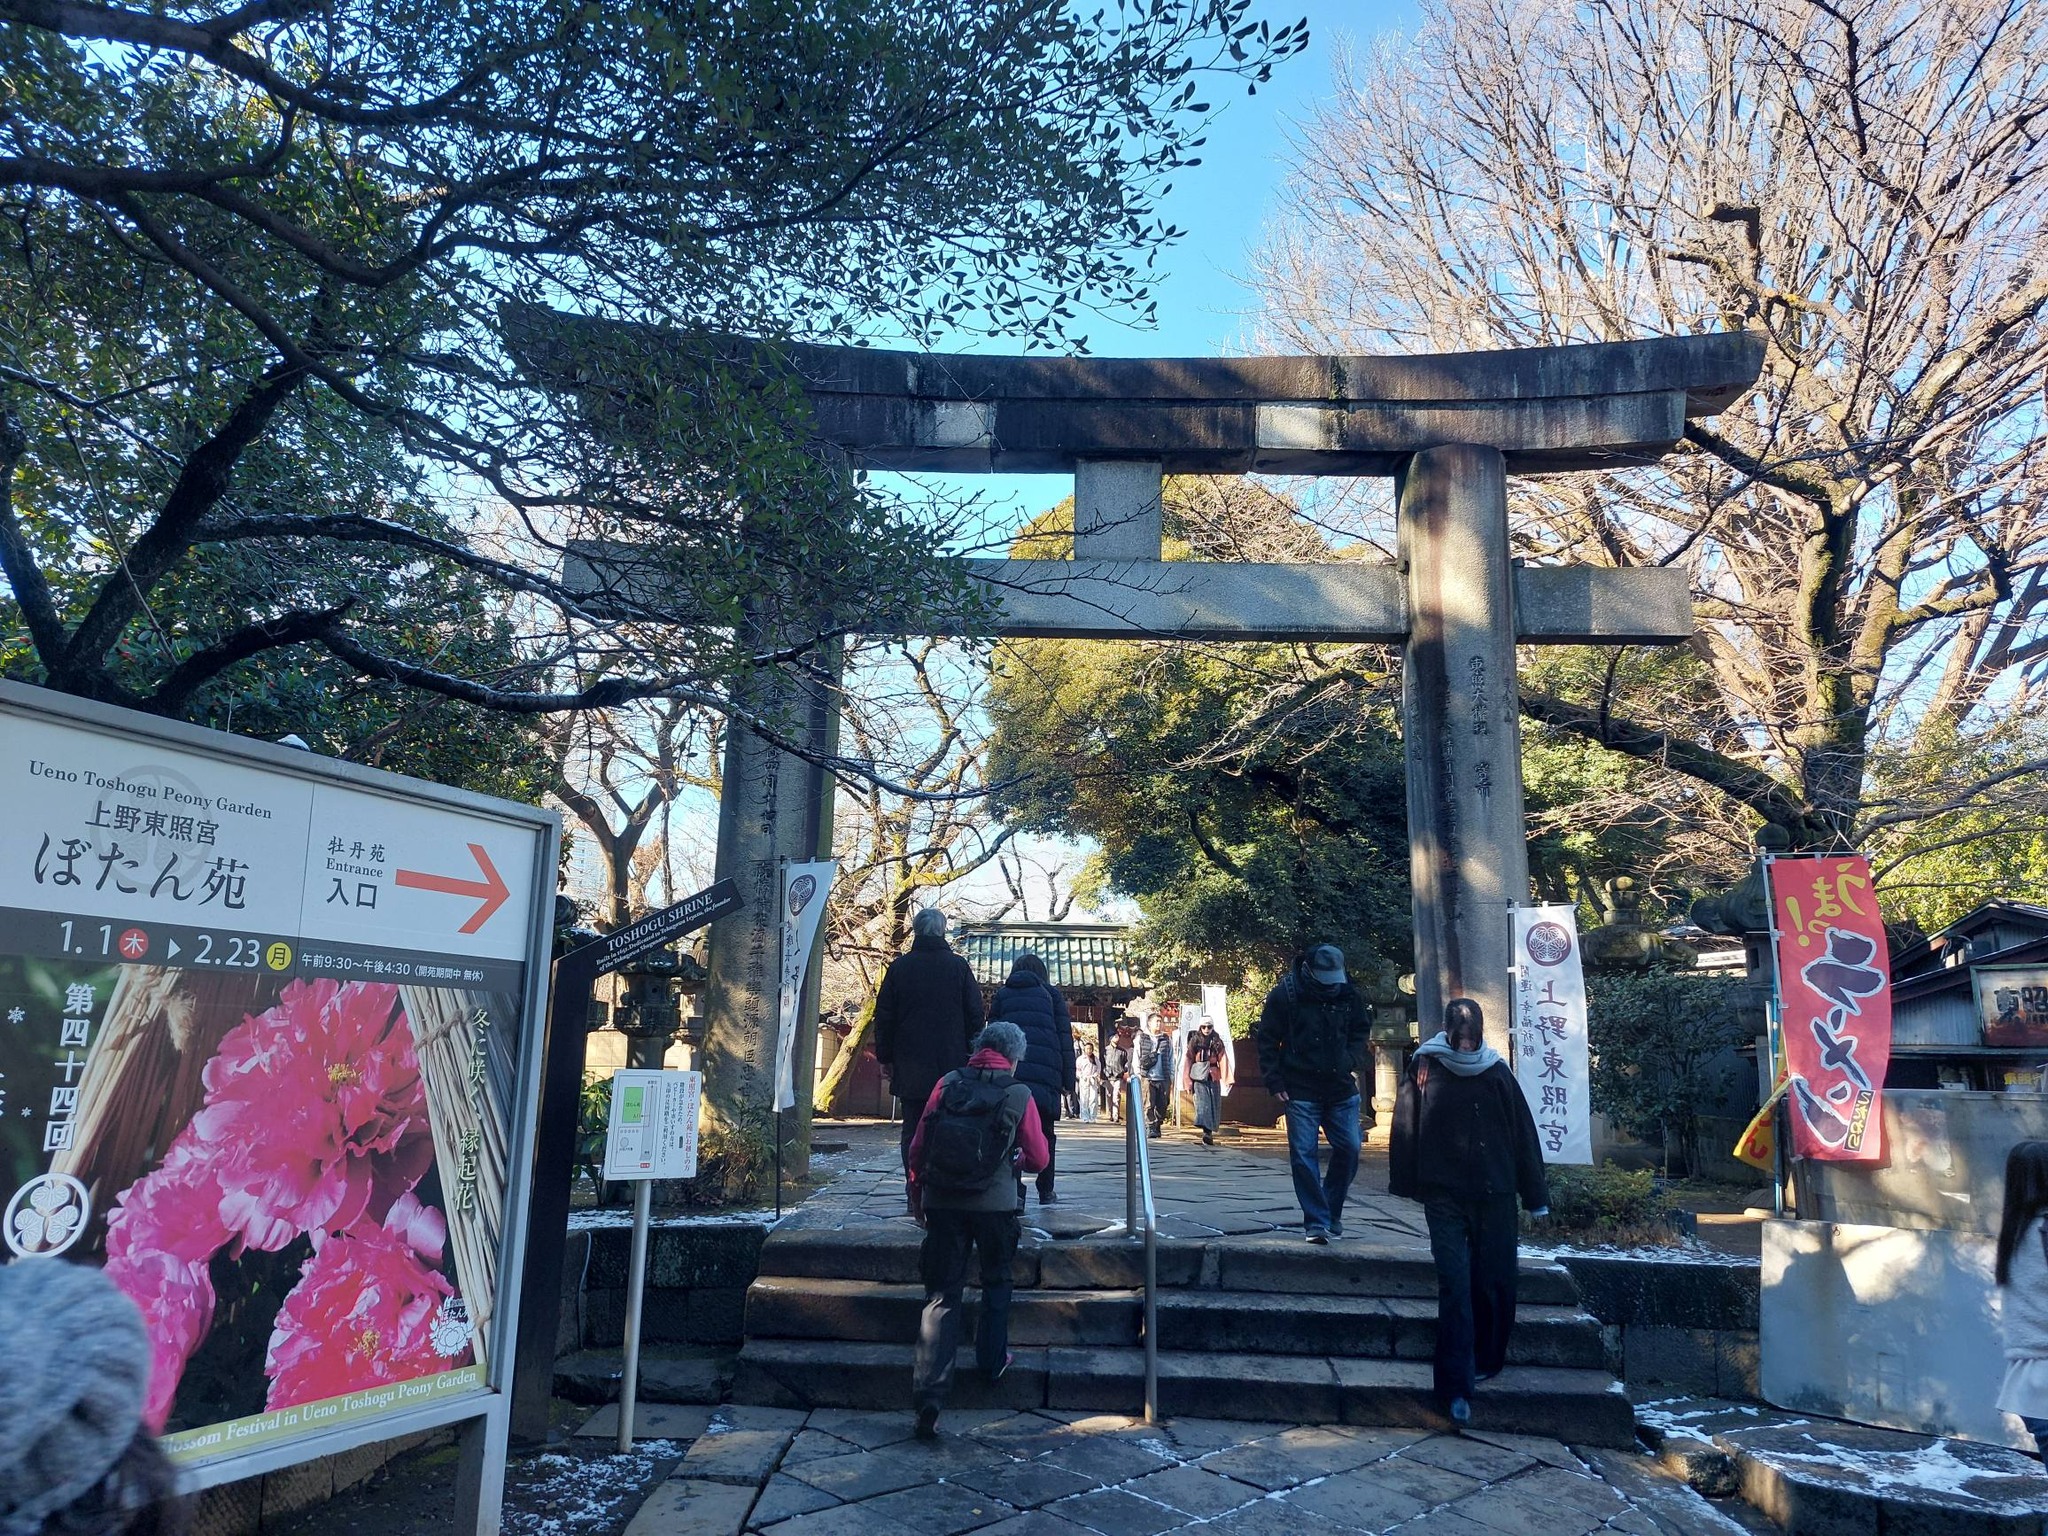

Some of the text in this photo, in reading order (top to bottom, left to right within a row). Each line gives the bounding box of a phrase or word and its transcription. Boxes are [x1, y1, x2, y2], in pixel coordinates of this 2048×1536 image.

[29, 760, 272, 819] Ueno Toshogu Peony Garden
[85, 800, 220, 846] 上野東照宮
[34, 832, 250, 909] ぼたん苑
[326, 857, 383, 878] Entrance
[327, 835, 386, 862] 牡丹苑
[326, 877, 378, 909] 入口
[596, 954, 610, 965] Built
[660, 920, 685, 934] Tokugawa
[607, 893, 713, 951] TOSHOGU SHRINE
[123, 932, 144, 954] 木
[194, 934, 260, 968] 2.23
[270, 947, 287, 966] 月
[614, 948, 640, 964] Tokugawa
[43, 982, 97, 1152] 第四十四回
[226, 1413, 280, 1441] Festival
[284, 1412, 298, 1426] in
[302, 1403, 337, 1422] Ueno
[342, 1389, 396, 1413] Toshogu
[398, 1382, 434, 1400] Peony
[437, 1370, 476, 1390] Garden
